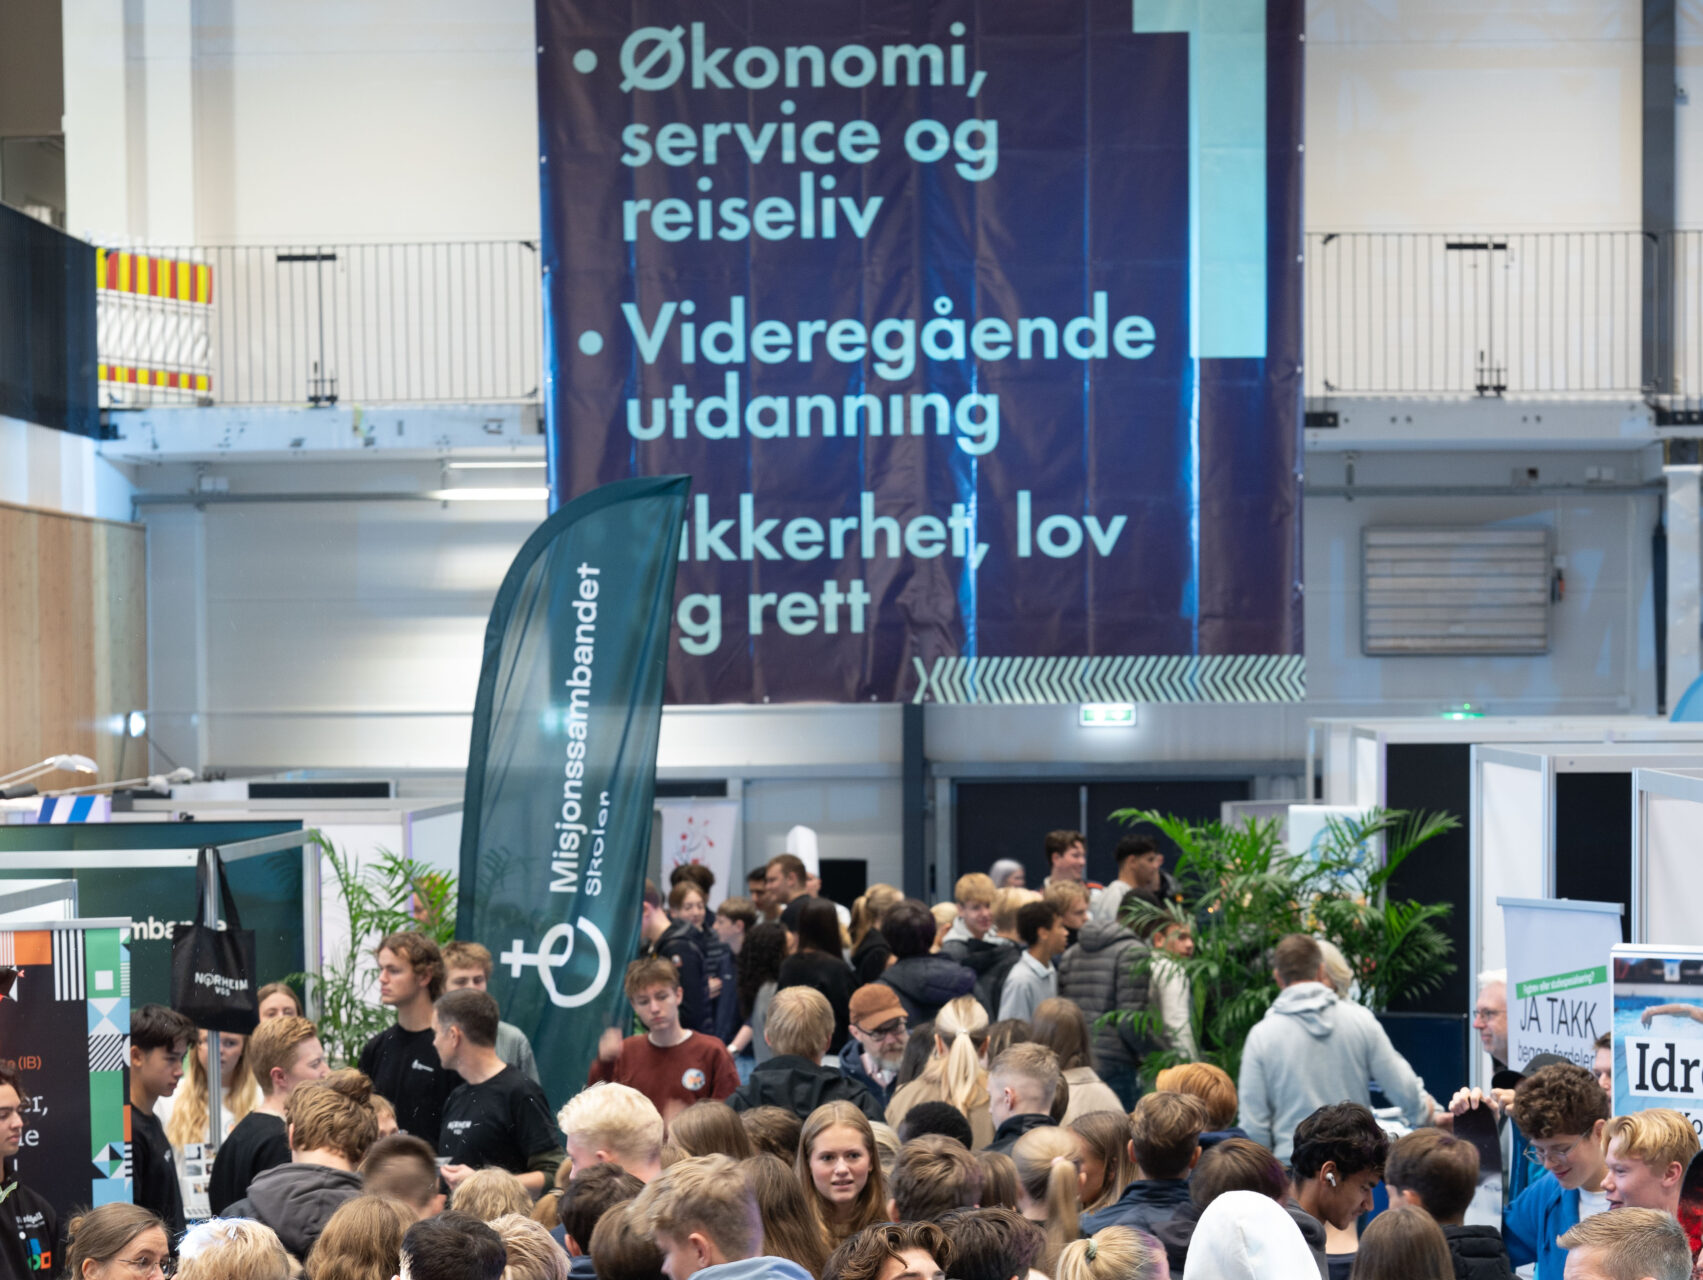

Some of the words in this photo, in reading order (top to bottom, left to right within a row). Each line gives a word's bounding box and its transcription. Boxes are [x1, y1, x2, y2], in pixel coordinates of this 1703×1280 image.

[620, 22, 988, 97] Økonomi,
[621, 100, 881, 167] service
[904, 118, 999, 181] og
[622, 172, 884, 242] reiseliv
[622, 291, 1157, 381] Videregående
[626, 371, 1000, 455] utdanning
[678, 490, 990, 568] ikkerhet,
[1016, 489, 1128, 559] lov
[676, 593, 722, 656] g
[748, 579, 872, 636] rett
[549, 562, 602, 893] Misjonssambandet
[194, 971, 249, 991] NORHEIM
[1520, 994, 1542, 1033] JA
[1546, 996, 1598, 1041] TAKK
[17, 1055, 42, 1071] (IB)
[1634, 1042, 1703, 1093] Idr
